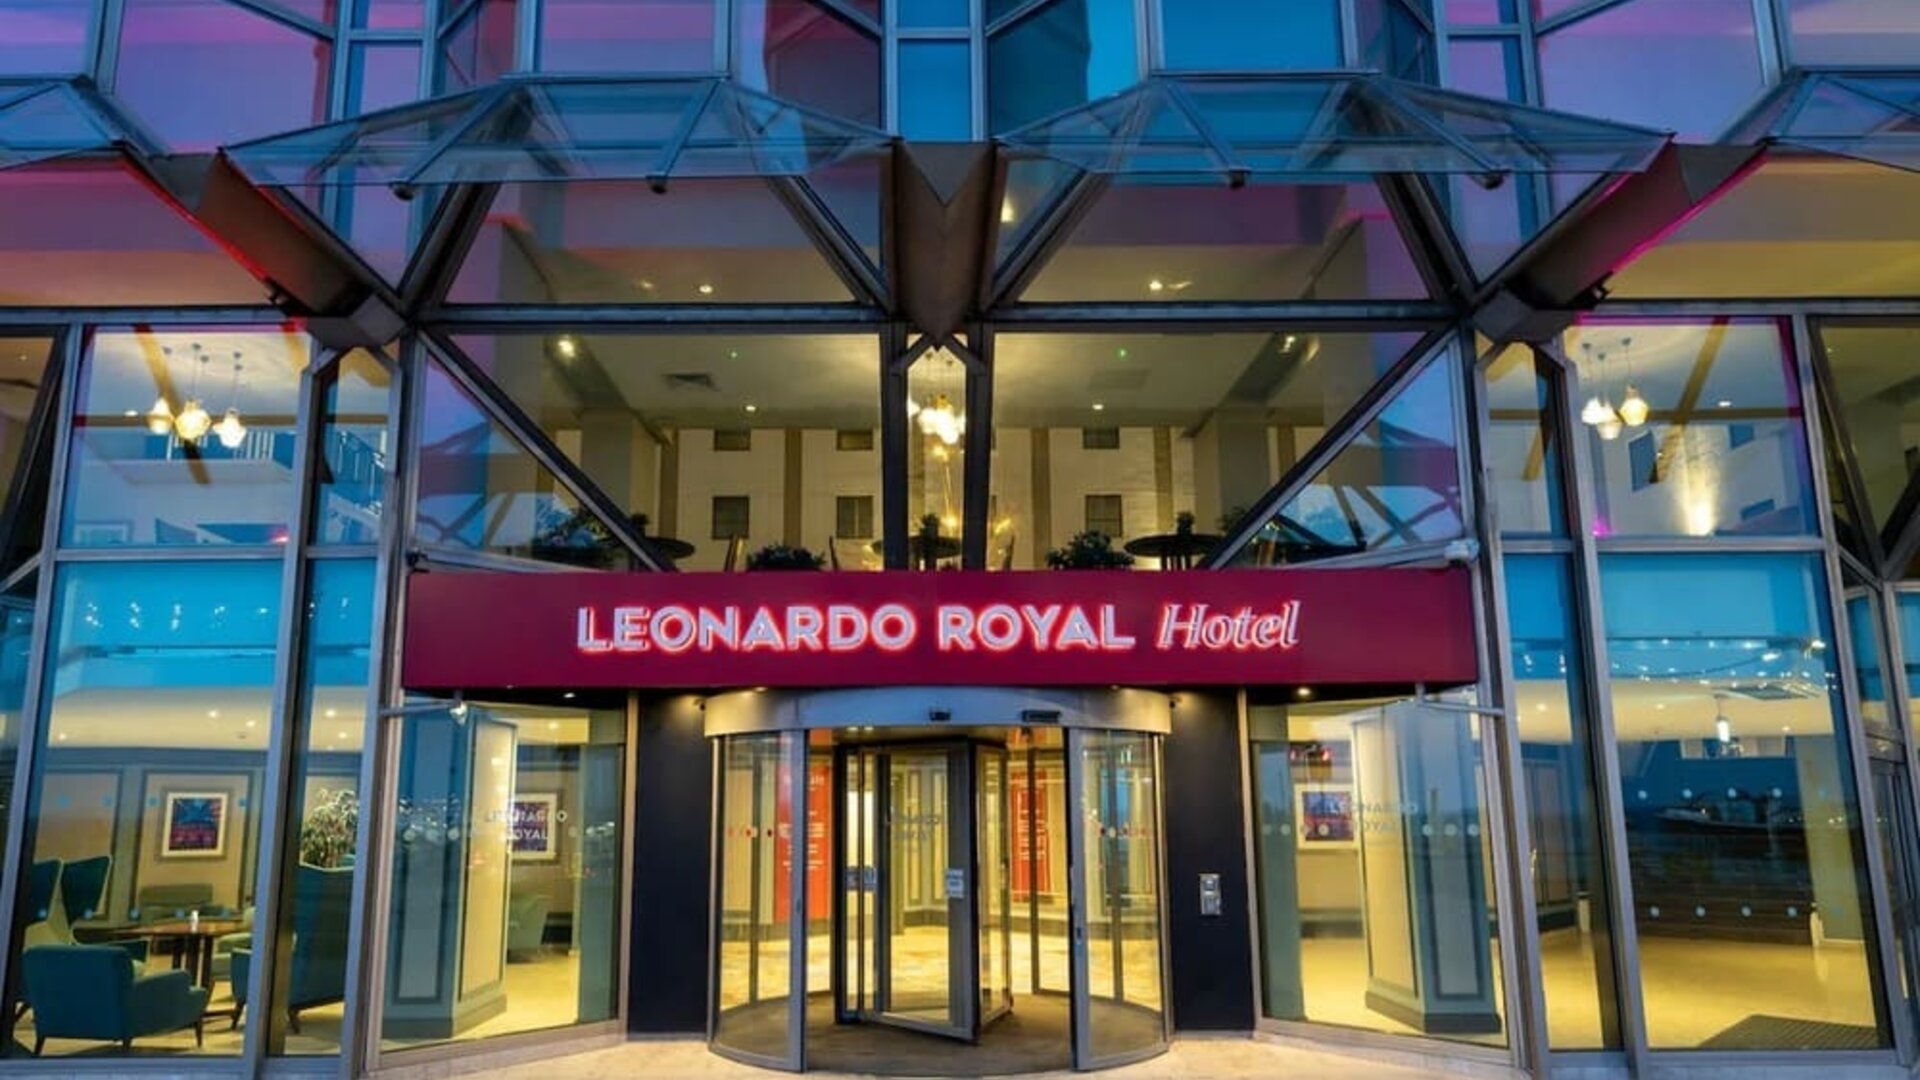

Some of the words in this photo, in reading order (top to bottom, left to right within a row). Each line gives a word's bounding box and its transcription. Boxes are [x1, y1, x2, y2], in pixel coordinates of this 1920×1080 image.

[576, 604, 917, 652] LEONARDO
[937, 604, 1137, 652] ROYAL
[1156, 600, 1300, 650] Hotel
